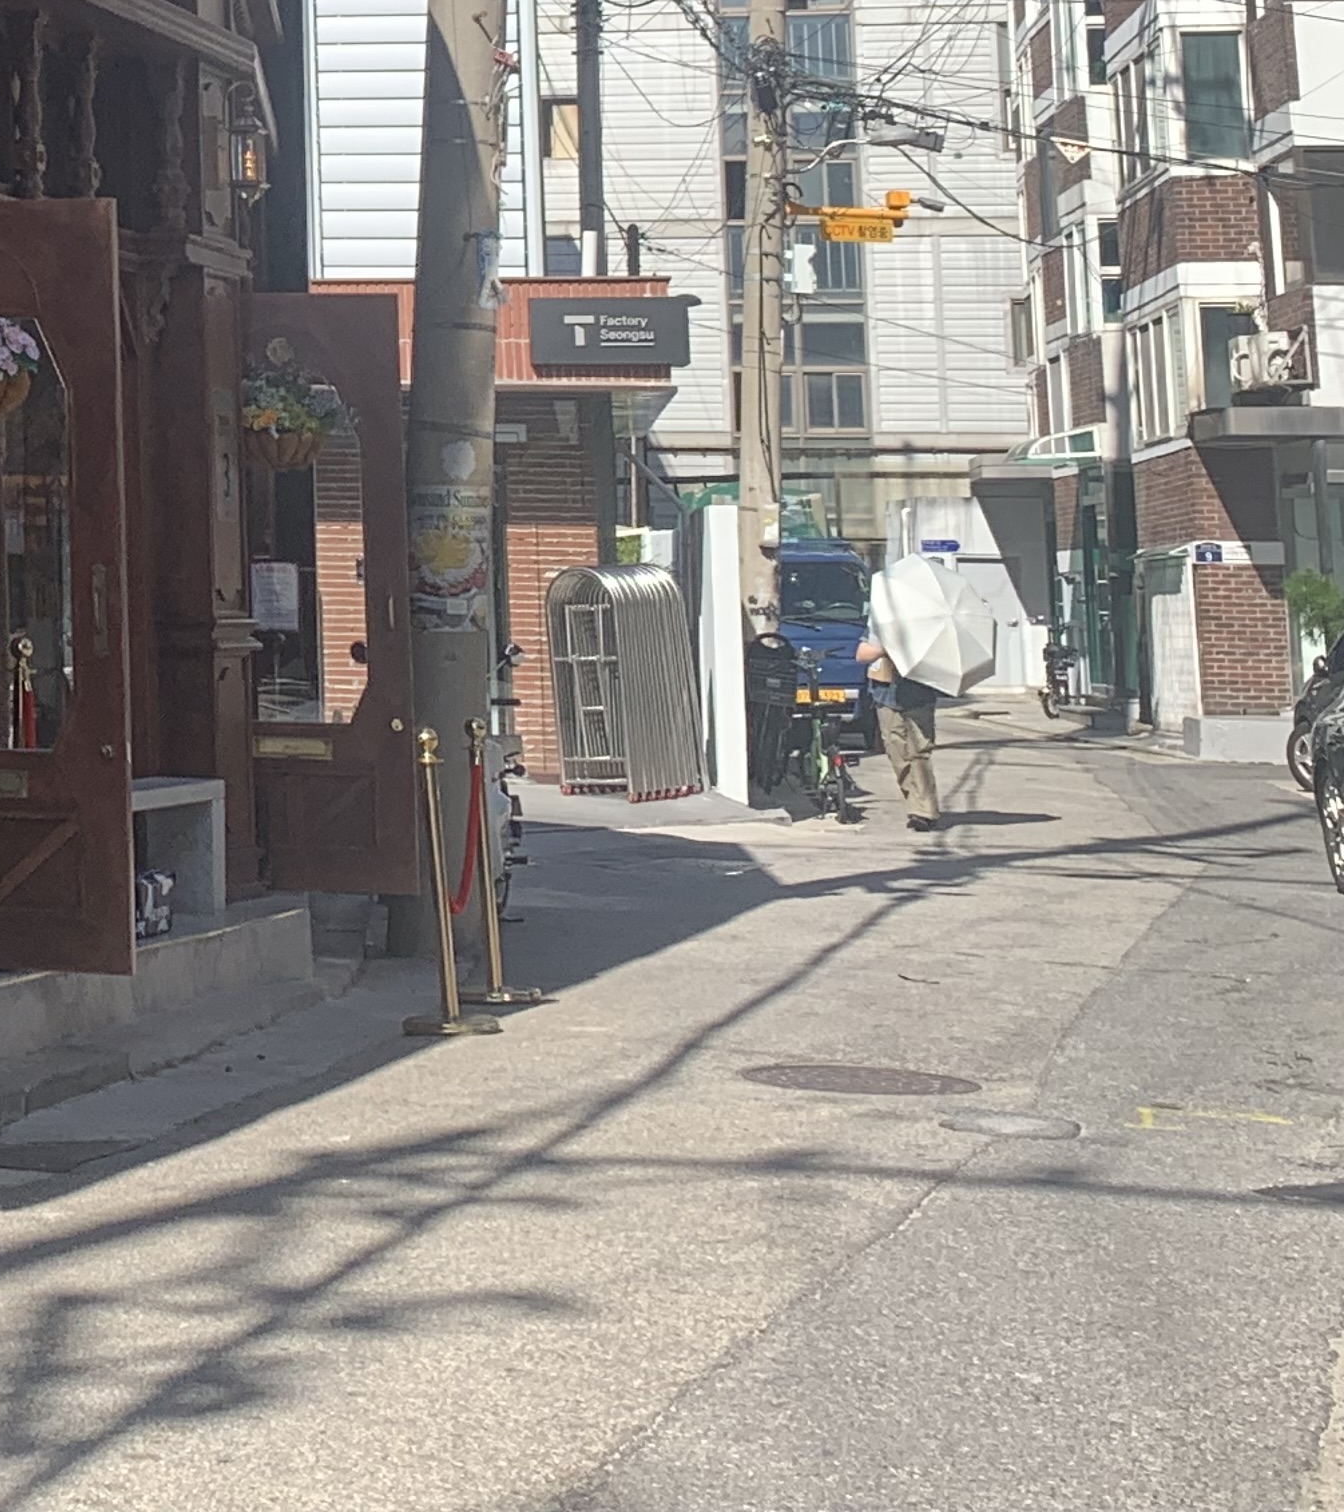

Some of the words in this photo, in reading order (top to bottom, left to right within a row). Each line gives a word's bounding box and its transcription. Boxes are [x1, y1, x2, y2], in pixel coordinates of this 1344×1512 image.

[824, 224, 854, 238] CCTV
[599, 315, 648, 328] Factory
[600, 329, 654, 341] Seongsu
